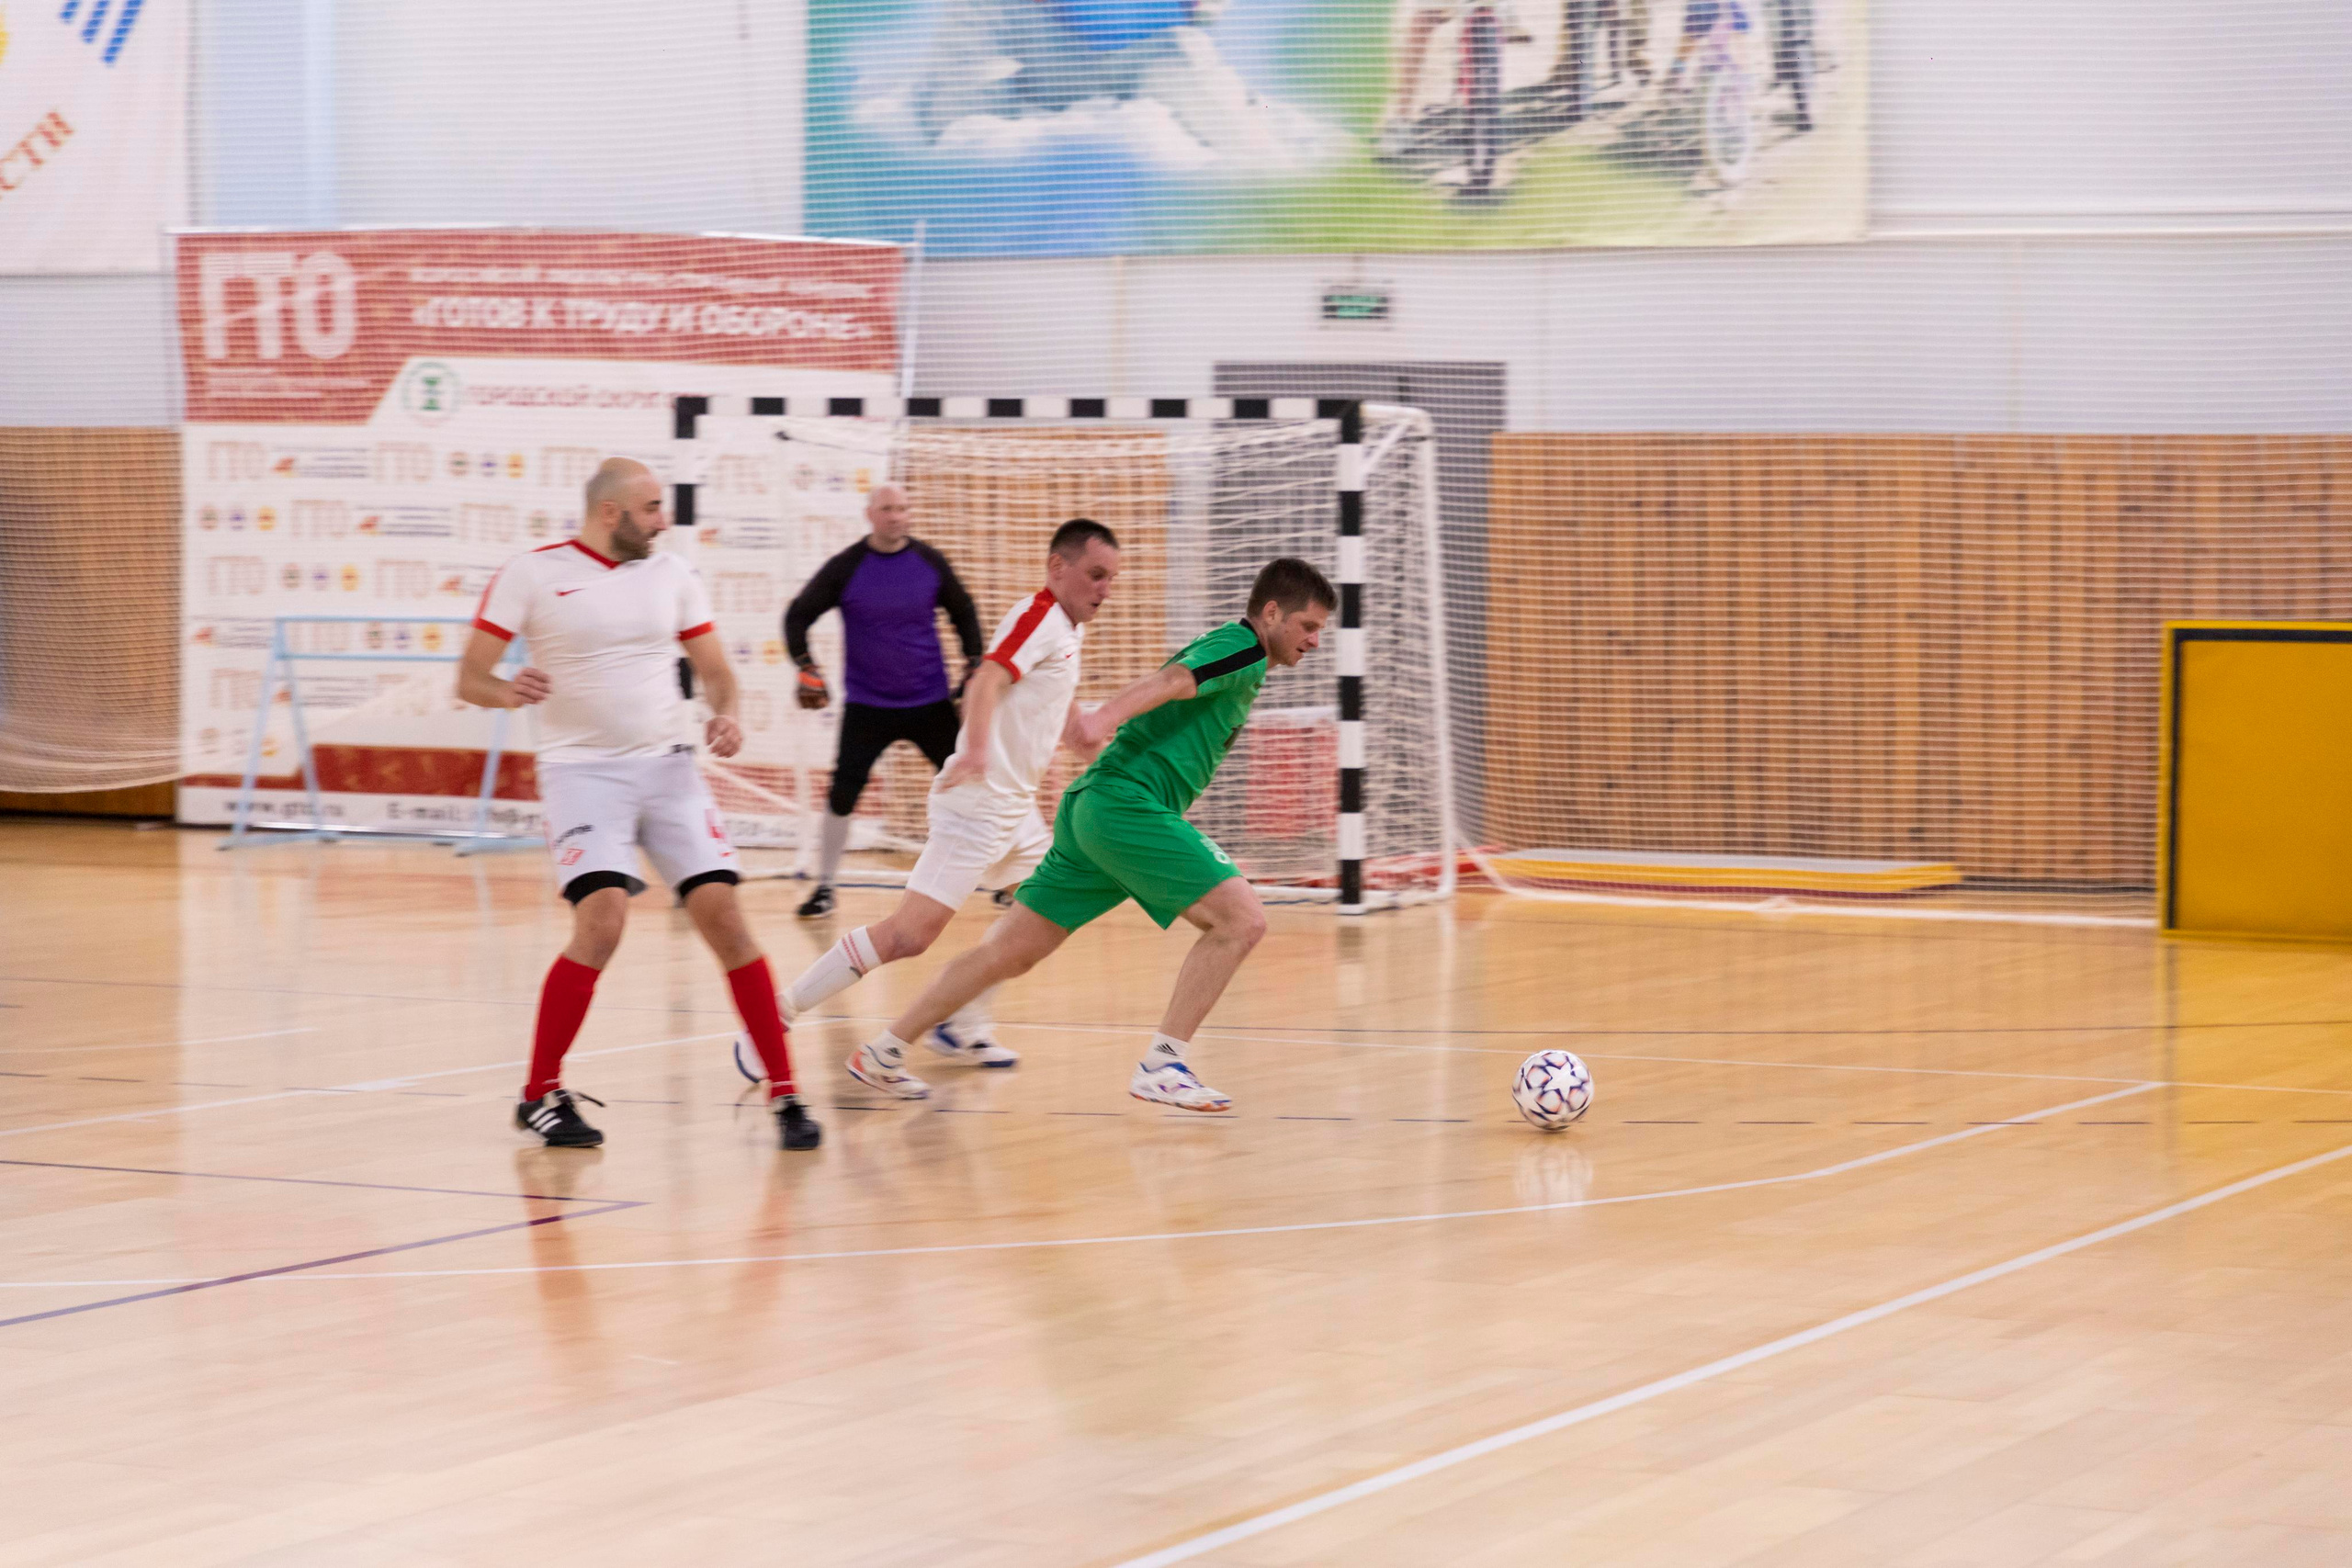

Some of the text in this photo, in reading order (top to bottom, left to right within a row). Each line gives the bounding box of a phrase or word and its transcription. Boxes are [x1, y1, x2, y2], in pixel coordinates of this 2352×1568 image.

[199, 252, 357, 359] ГТО
[533, 297, 554, 329] К
[559, 297, 660, 335] ТРУДУ
[667, 303, 694, 333] И
